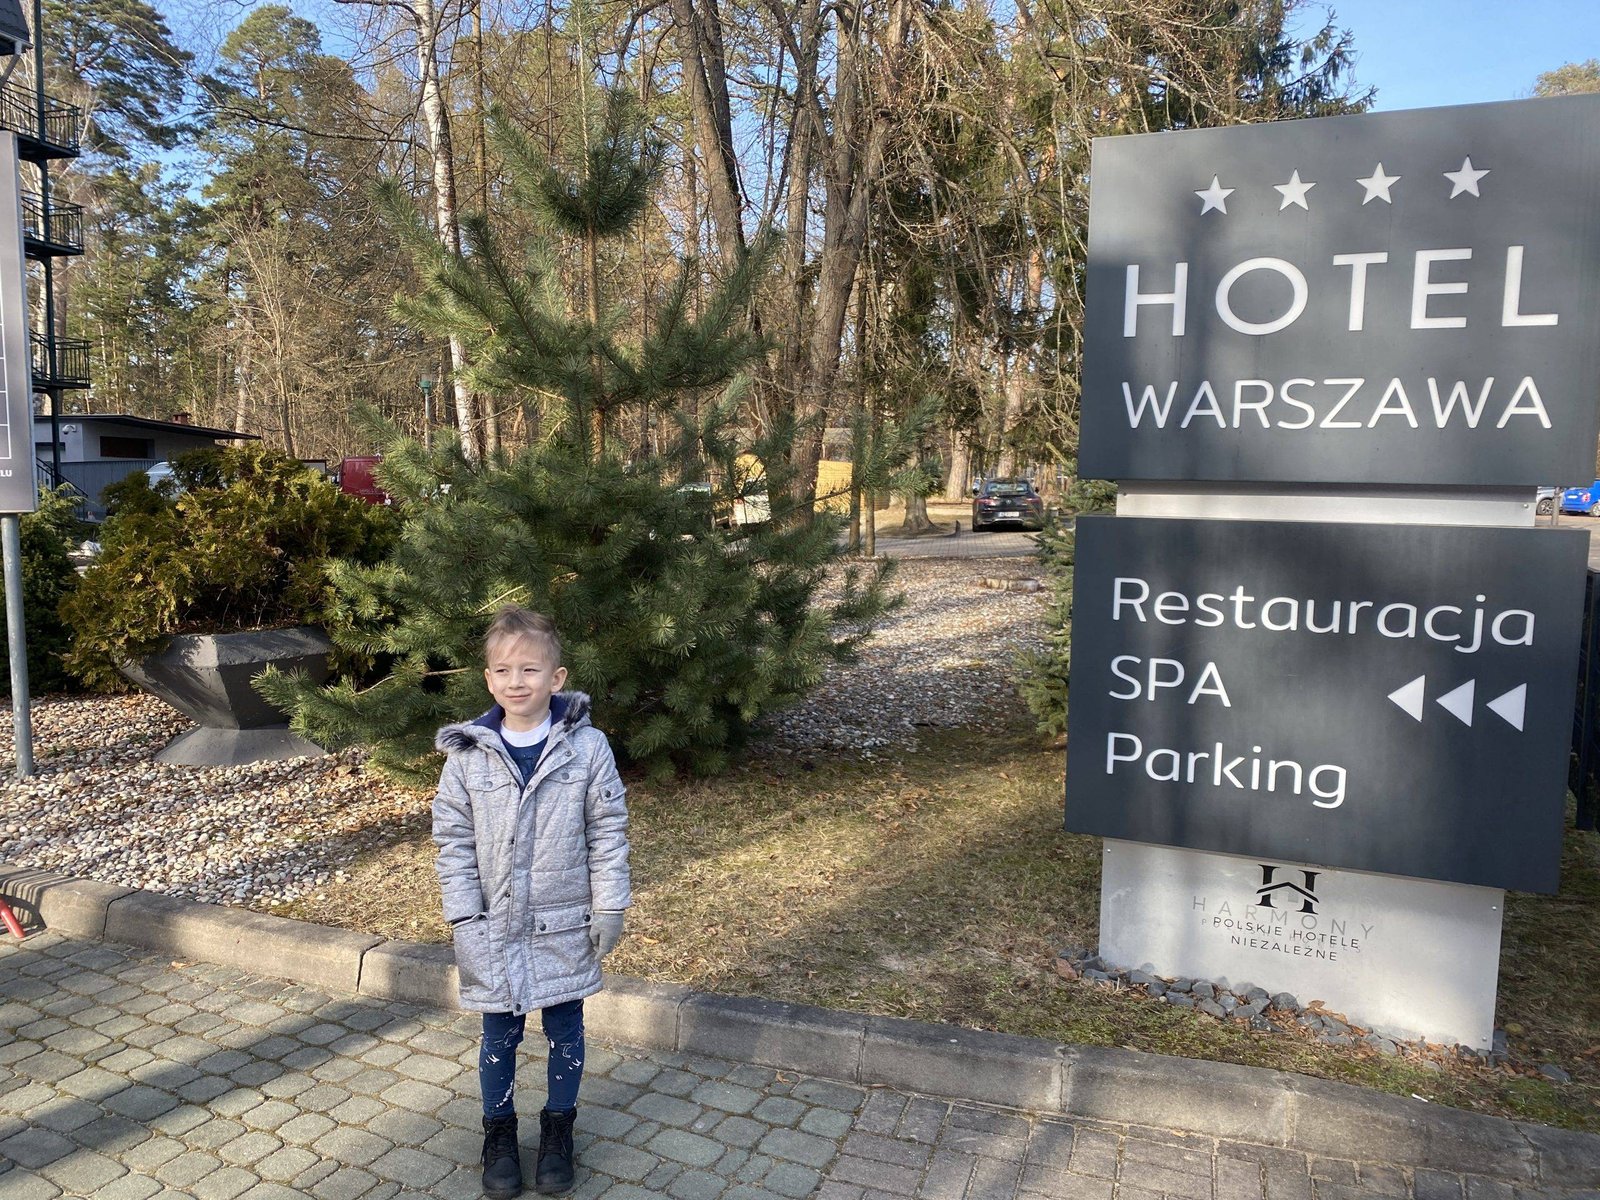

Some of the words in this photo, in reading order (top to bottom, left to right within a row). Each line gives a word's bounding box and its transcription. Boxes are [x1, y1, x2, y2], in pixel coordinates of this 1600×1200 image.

[1123, 245, 1559, 338] HOTEL
[1122, 376, 1553, 430] WARSZAWA
[1112, 577, 1536, 654] Restauracja
[1108, 655, 1232, 708] SPA
[1106, 732, 1347, 809] Parking
[1192, 895, 1375, 940] HARMONY
[1213, 916, 1283, 936] POLSKIE
[1293, 929, 1360, 949] HOTELE
[1231, 935, 1338, 961] NIEZALEŻNE
